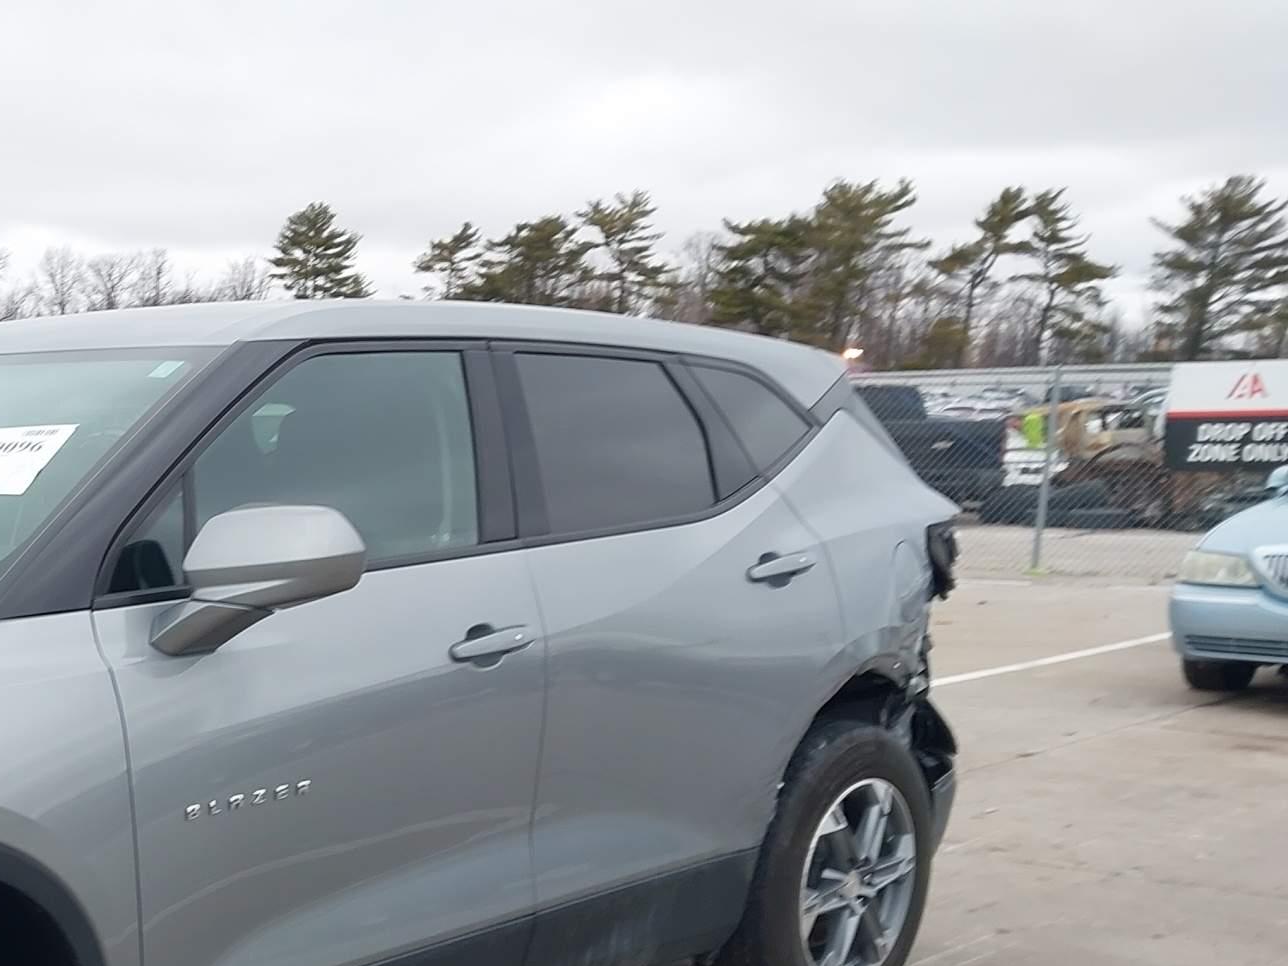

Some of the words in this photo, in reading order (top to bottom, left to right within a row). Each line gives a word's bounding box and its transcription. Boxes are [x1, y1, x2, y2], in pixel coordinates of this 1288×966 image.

[1196, 422, 1252, 442] DROP
[1186, 443, 1241, 462] ZONE
[184, 779, 312, 821] BLAZER
